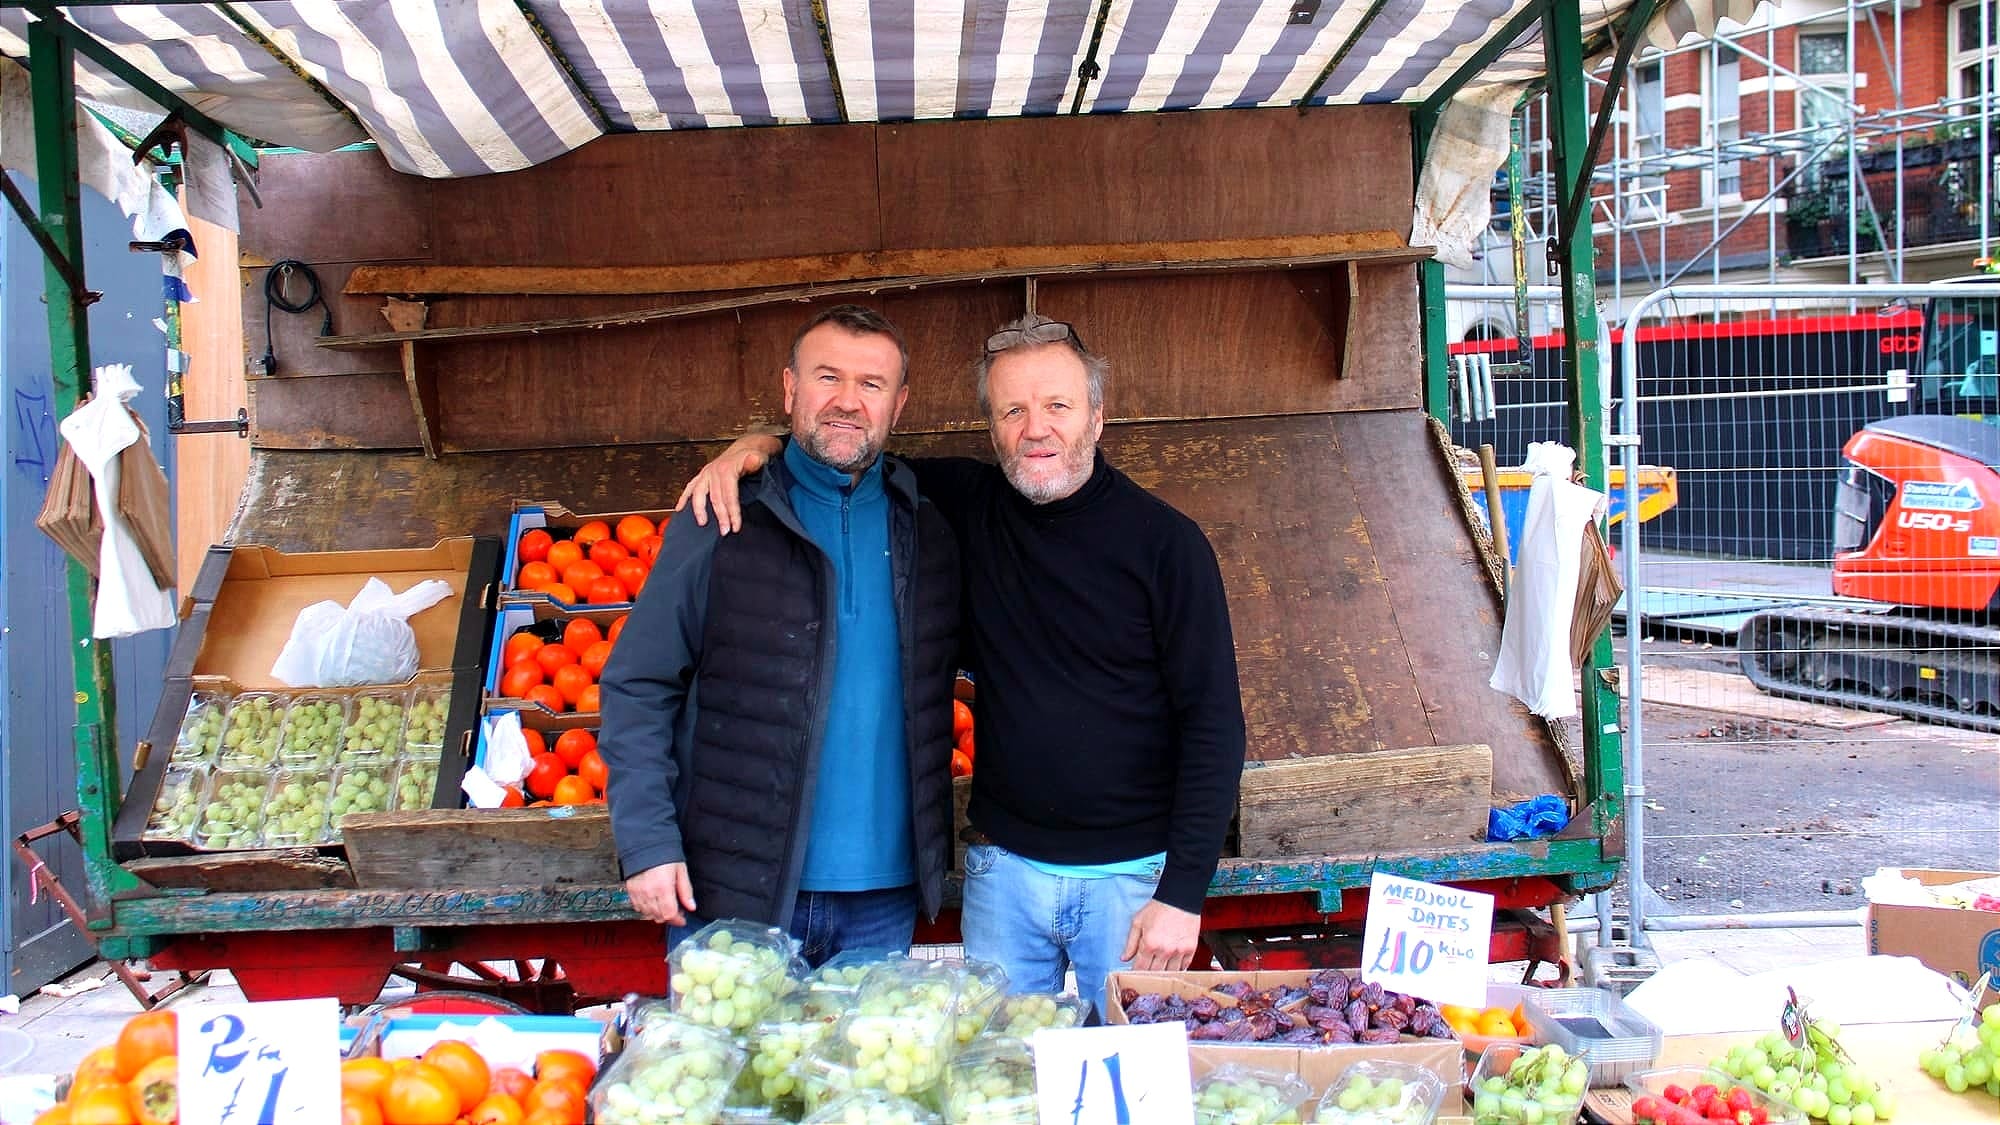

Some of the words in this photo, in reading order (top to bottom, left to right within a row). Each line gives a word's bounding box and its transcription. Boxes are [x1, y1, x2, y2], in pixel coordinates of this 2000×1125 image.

[1384, 884, 1473, 908] MEDJOUL
[1409, 907, 1470, 932] DATES
[1369, 927, 1433, 975] £10
[200, 1014, 250, 1077] 2
